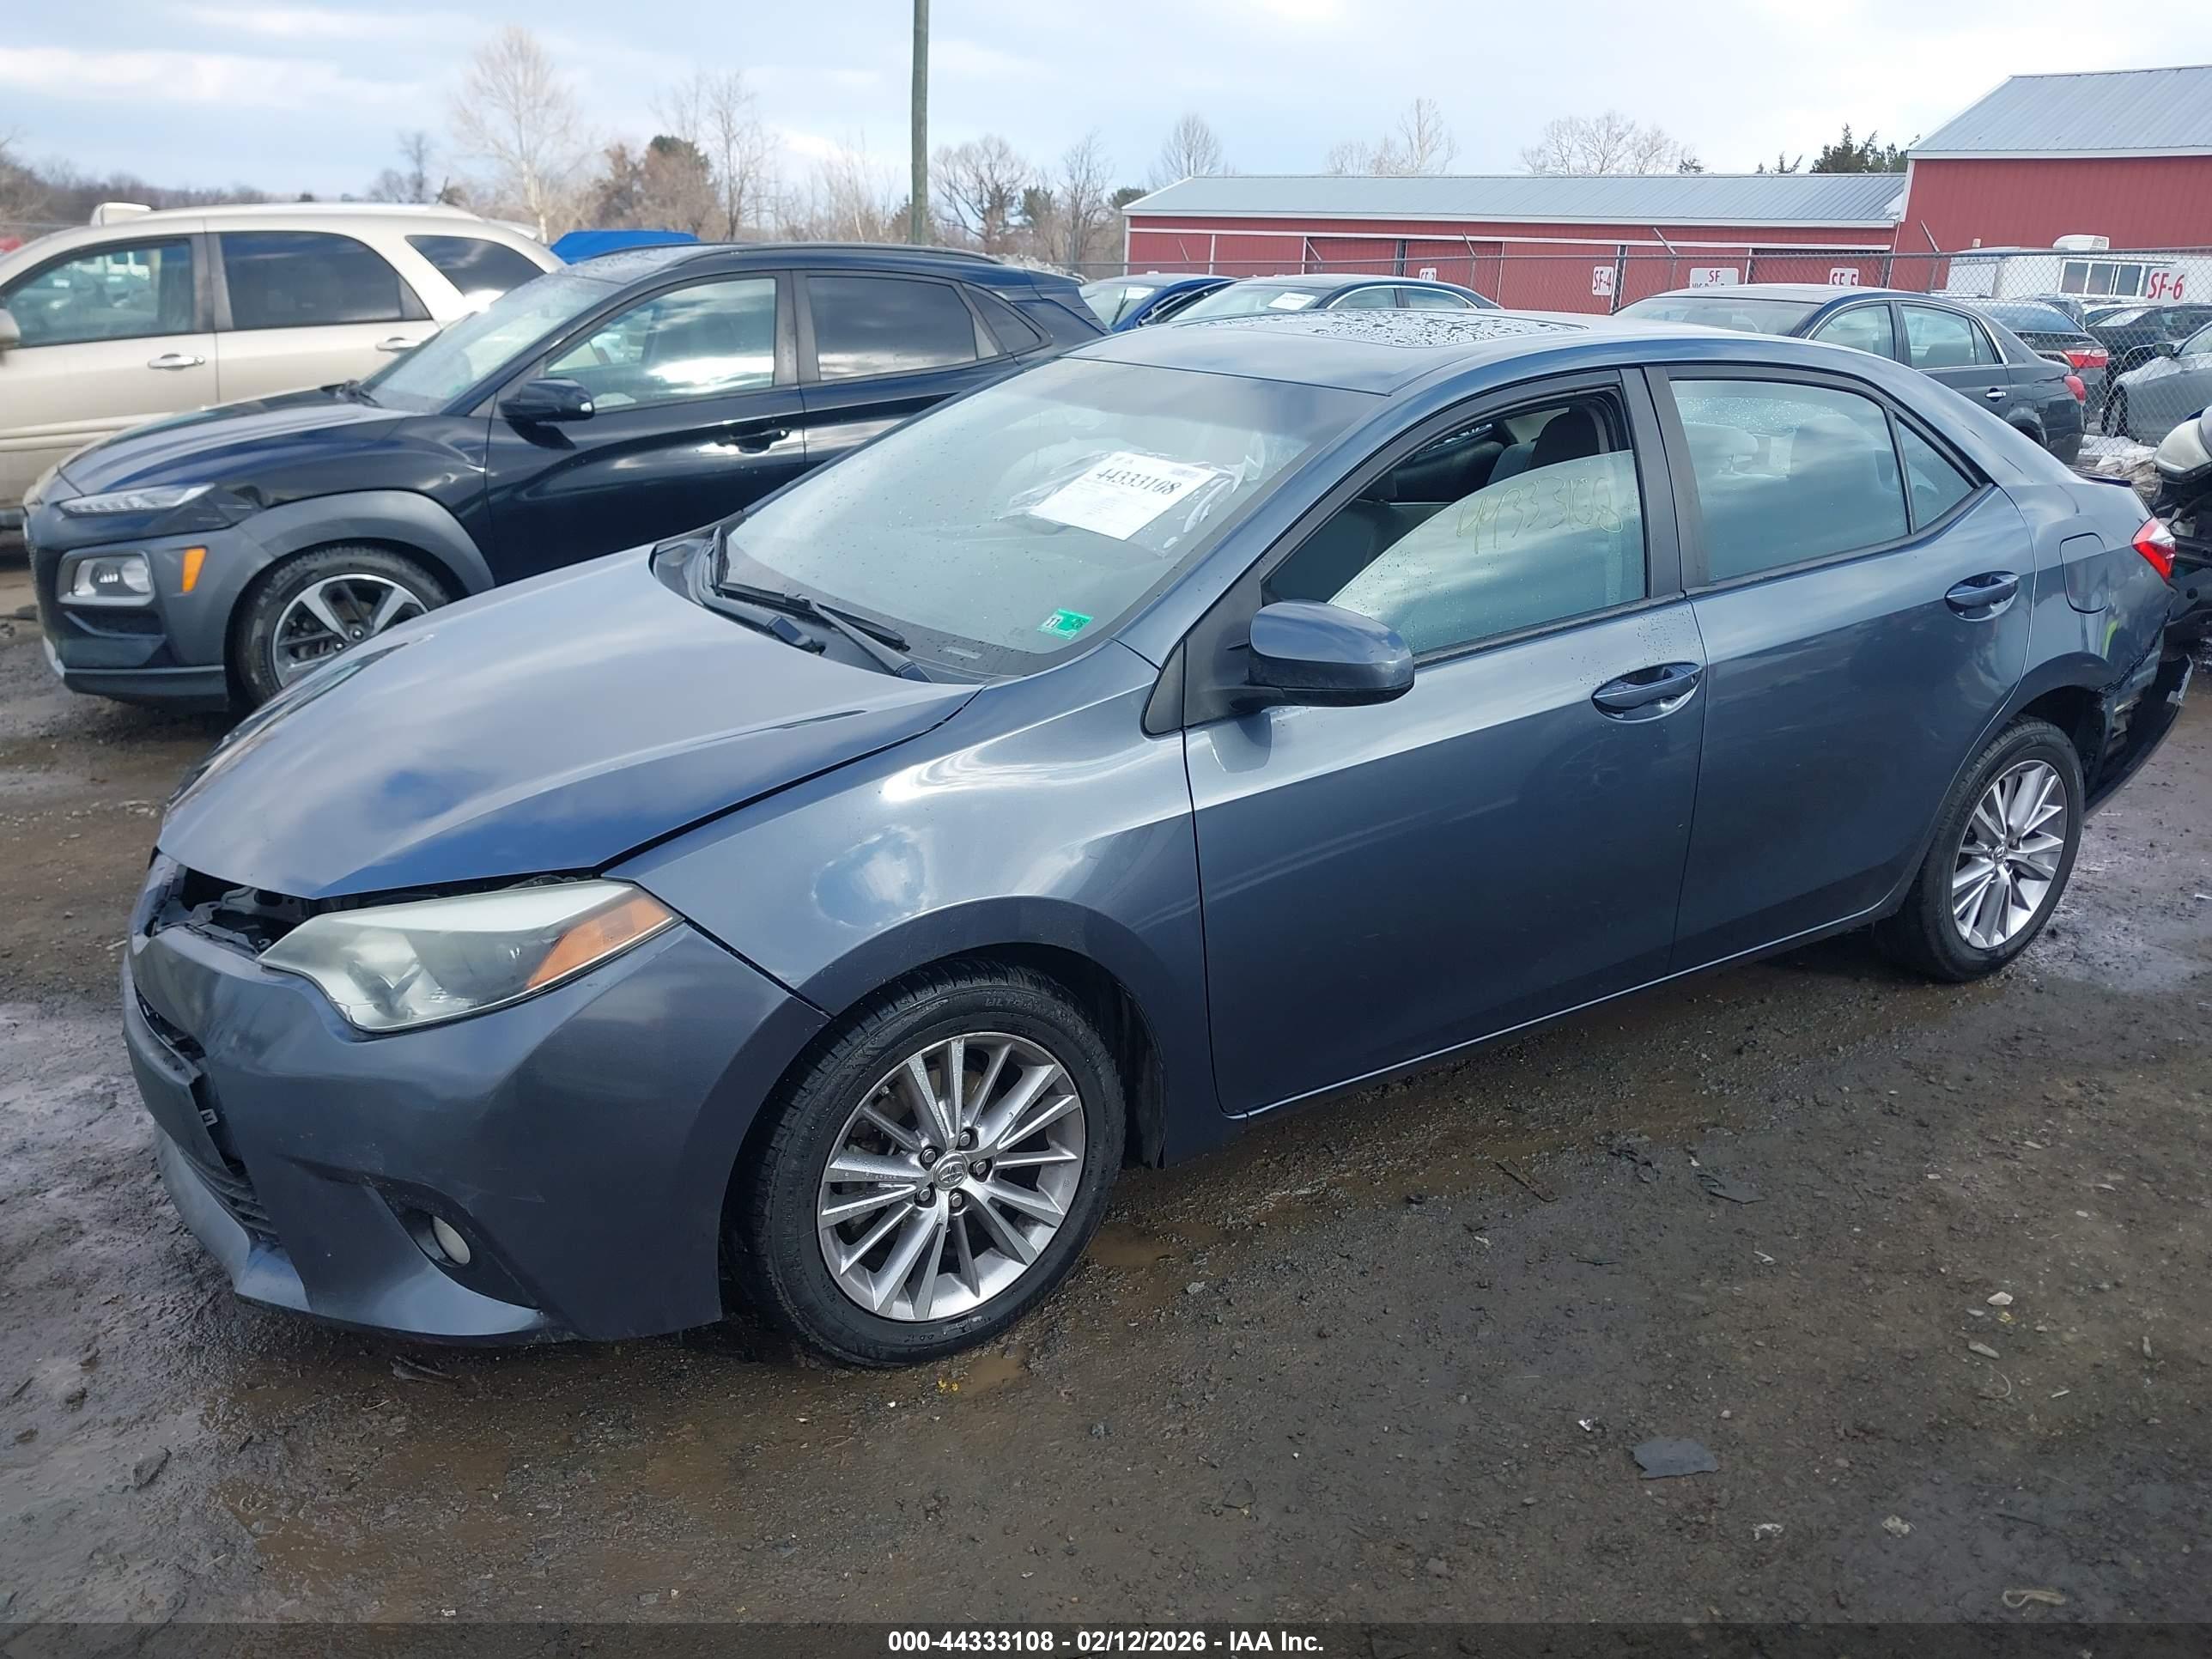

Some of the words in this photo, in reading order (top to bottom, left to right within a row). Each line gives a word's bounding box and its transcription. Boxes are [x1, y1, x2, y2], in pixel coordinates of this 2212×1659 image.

[1593, 270, 1612, 291] SF-4
[1708, 270, 1721, 283] SF
[2148, 272, 2185, 300] SF-6
[1096, 467, 1182, 495] 44333108
[1456, 476, 1623, 554] 44333108
